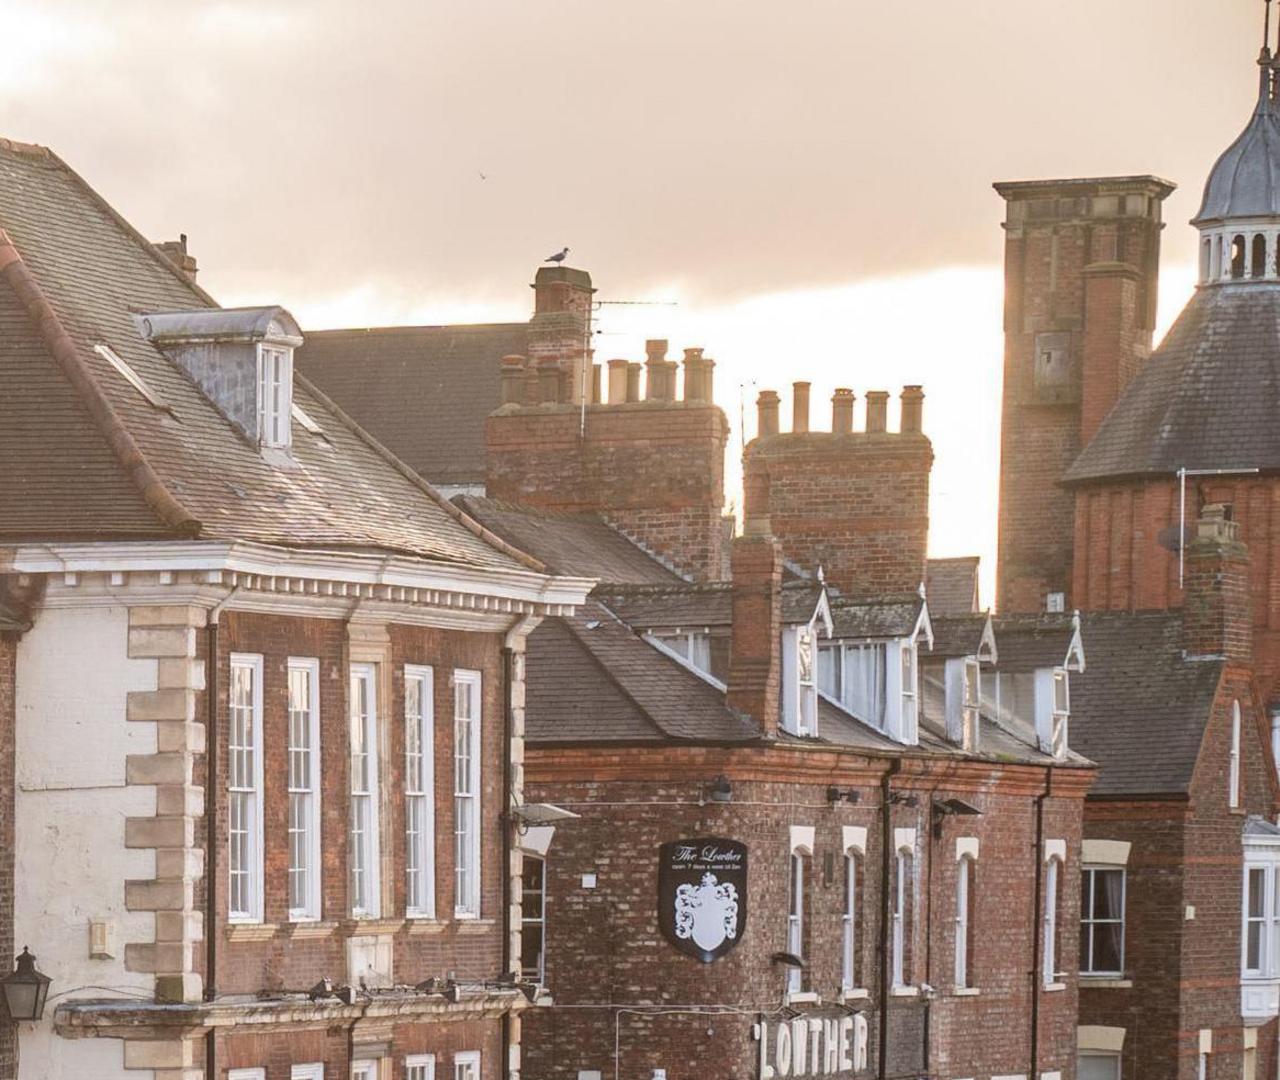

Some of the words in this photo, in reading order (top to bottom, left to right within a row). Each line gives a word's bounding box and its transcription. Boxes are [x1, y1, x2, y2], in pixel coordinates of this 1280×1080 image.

[672, 846, 697, 861] The
[699, 845, 741, 862] Lowther
[760, 1014, 868, 1080] LOWTHER
